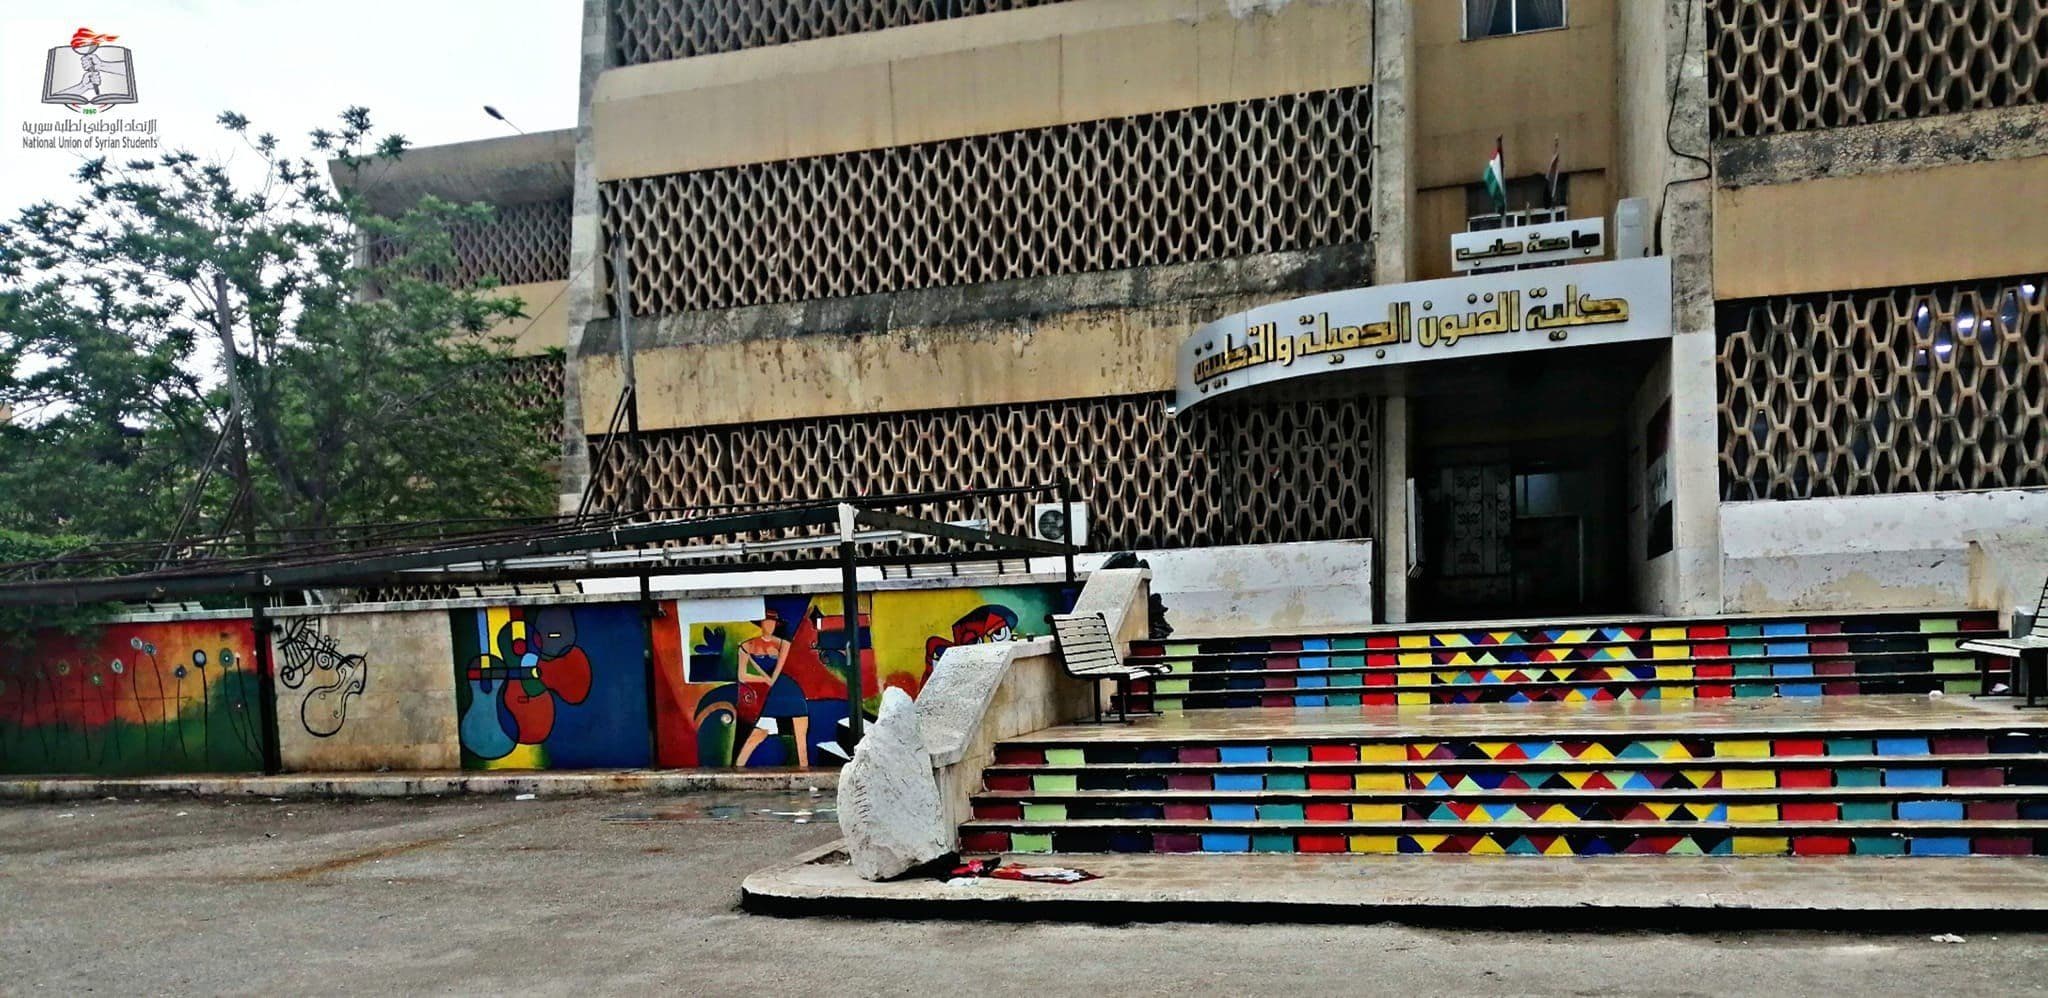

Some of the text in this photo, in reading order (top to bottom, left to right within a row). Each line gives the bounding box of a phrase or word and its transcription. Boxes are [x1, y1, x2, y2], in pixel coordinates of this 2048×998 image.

[1456, 230, 1600, 267] جامعة حلب
[1297, 302, 1411, 364] الجميلة
[1417, 290, 1520, 348] الفنون
[1526, 284, 1630, 341] كلية
